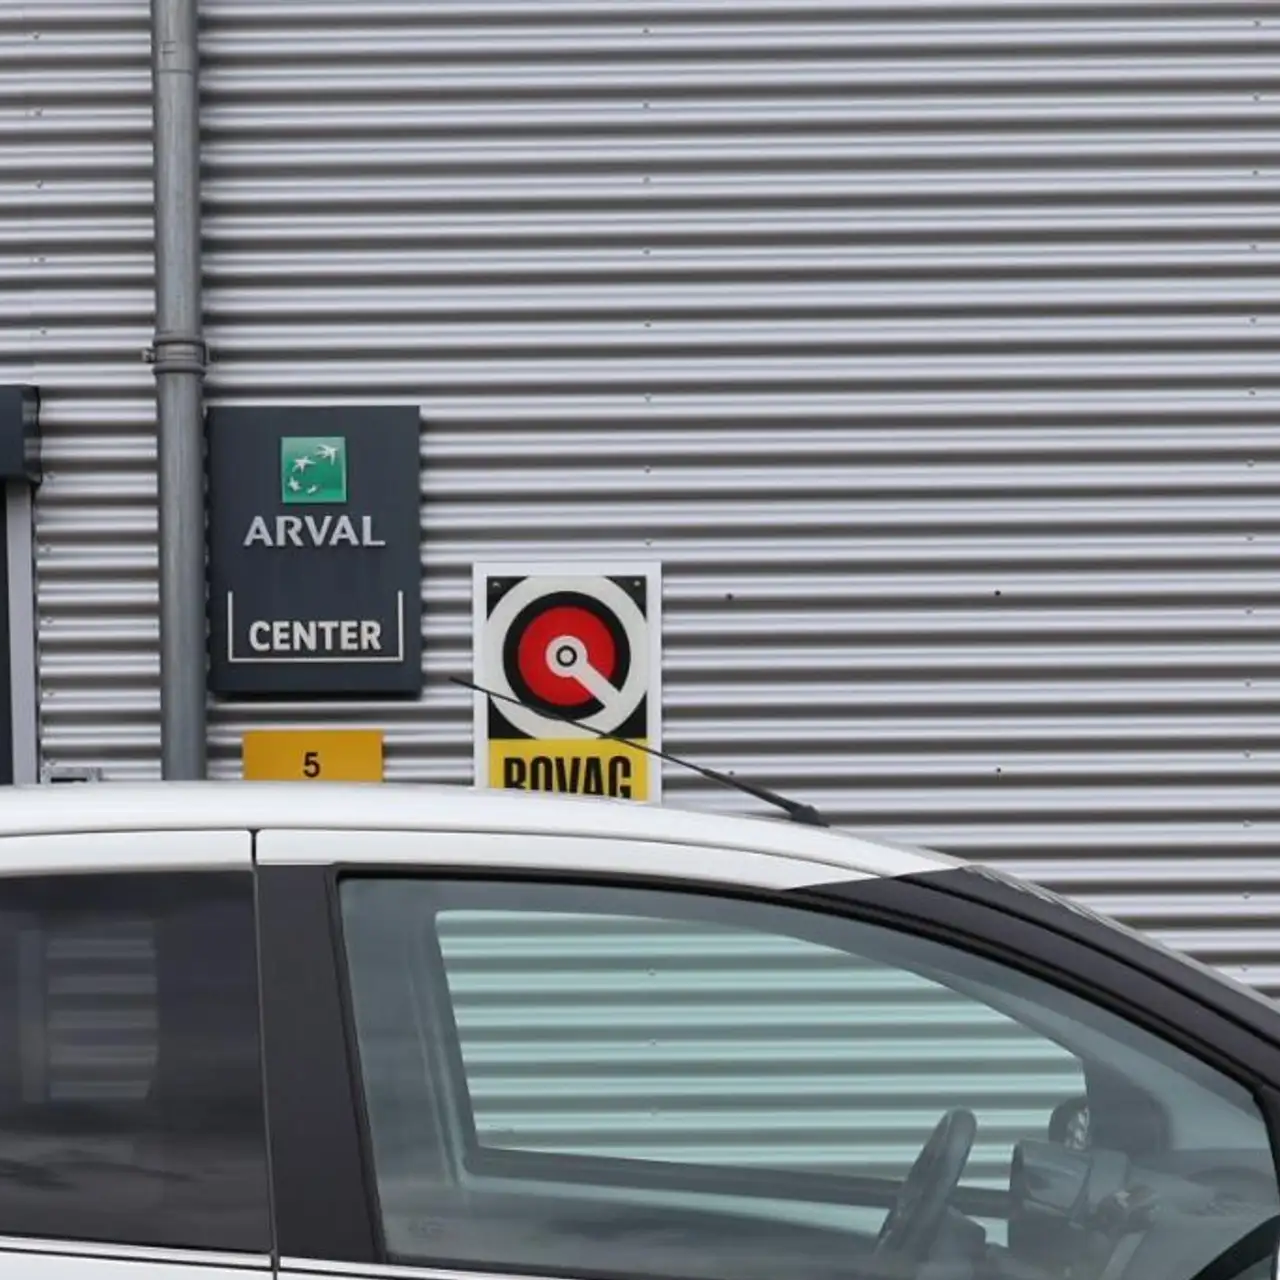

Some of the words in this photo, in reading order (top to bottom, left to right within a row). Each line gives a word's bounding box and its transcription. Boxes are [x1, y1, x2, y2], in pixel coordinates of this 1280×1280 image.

[244, 515, 386, 547] ARVAL
[249, 620, 381, 651] CENTER
[303, 752, 321, 778] 5
